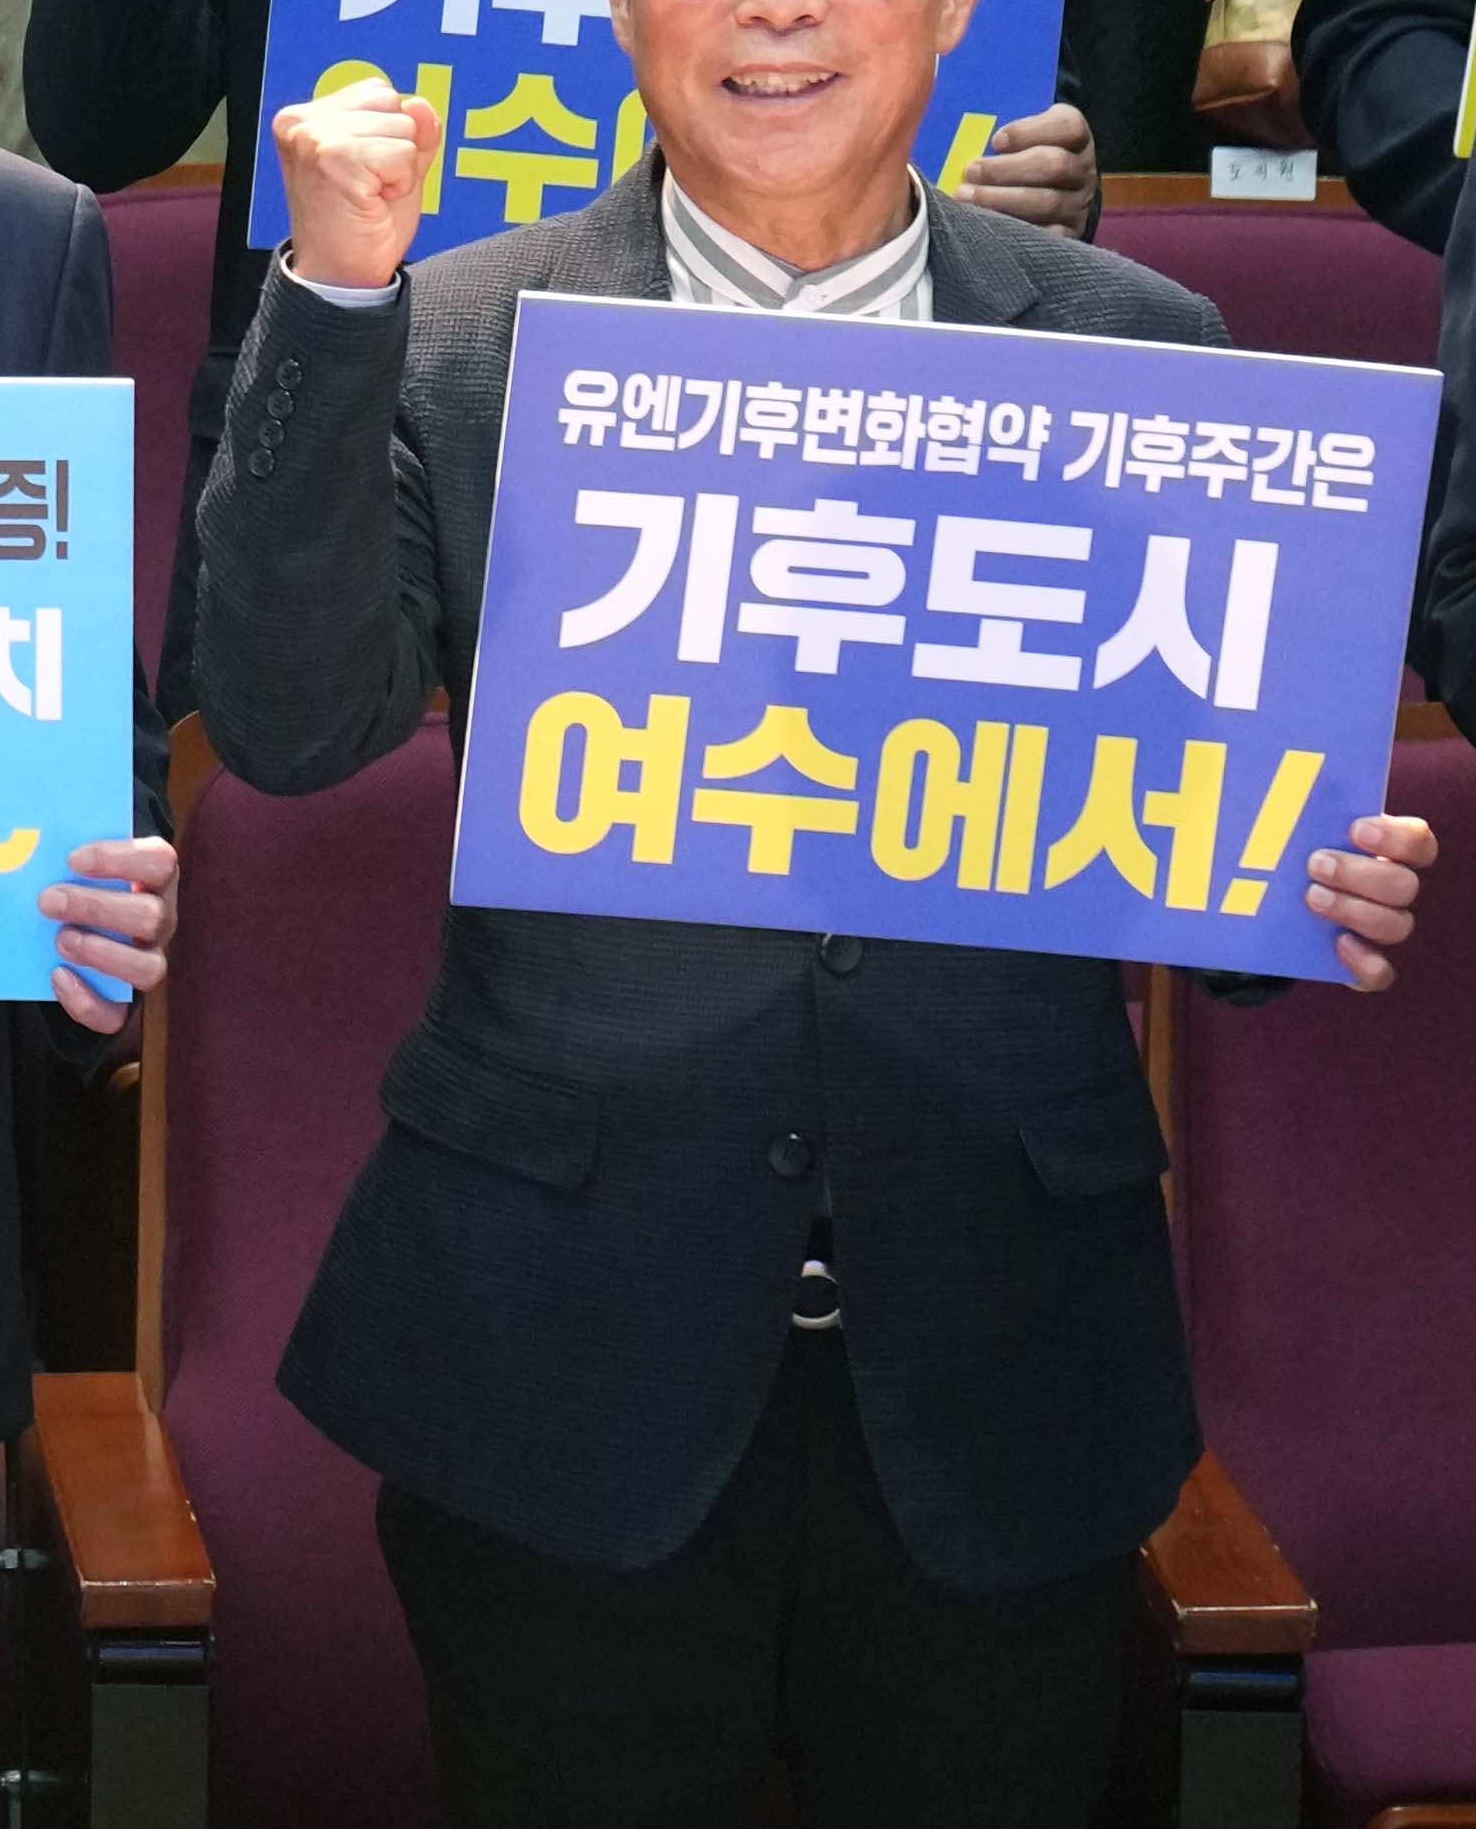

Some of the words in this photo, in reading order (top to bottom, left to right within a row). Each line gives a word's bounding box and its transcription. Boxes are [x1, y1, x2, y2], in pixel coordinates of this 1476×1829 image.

[555, 369, 1051, 483] 유엔기후변화협약
[1062, 407, 1377, 515] 기후주간은
[559, 488, 1281, 712] 기후도시
[518, 689, 1326, 917] 여수에서!
